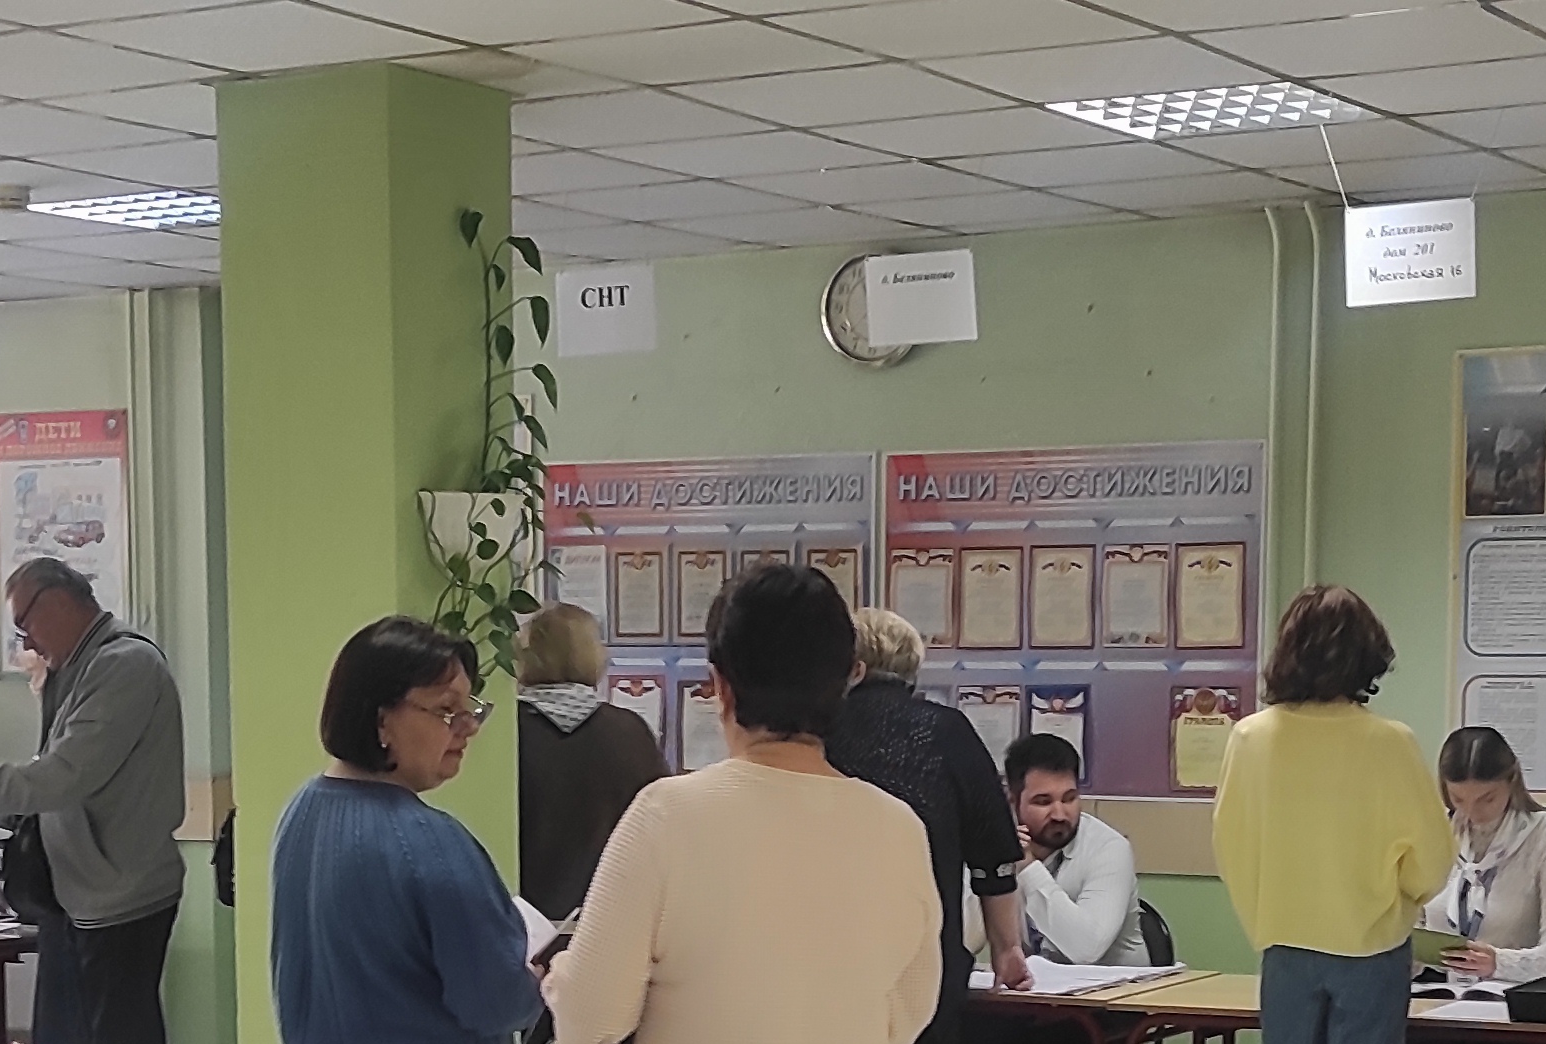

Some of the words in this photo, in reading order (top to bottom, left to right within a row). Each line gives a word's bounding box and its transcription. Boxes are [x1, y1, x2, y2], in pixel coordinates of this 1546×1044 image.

[1383, 247, 1406, 258] дом
[1368, 265, 1444, 284] Московская
[580, 285, 630, 309] СНТ
[34, 421, 81, 442] ДЕТИ
[553, 481, 639, 506] НАШИ
[652, 474, 865, 511] ДОСТИЖЕНИЯ
[898, 473, 996, 501] НАШИ
[1009, 464, 1252, 504] ДОСТИЖЕНИЯ
